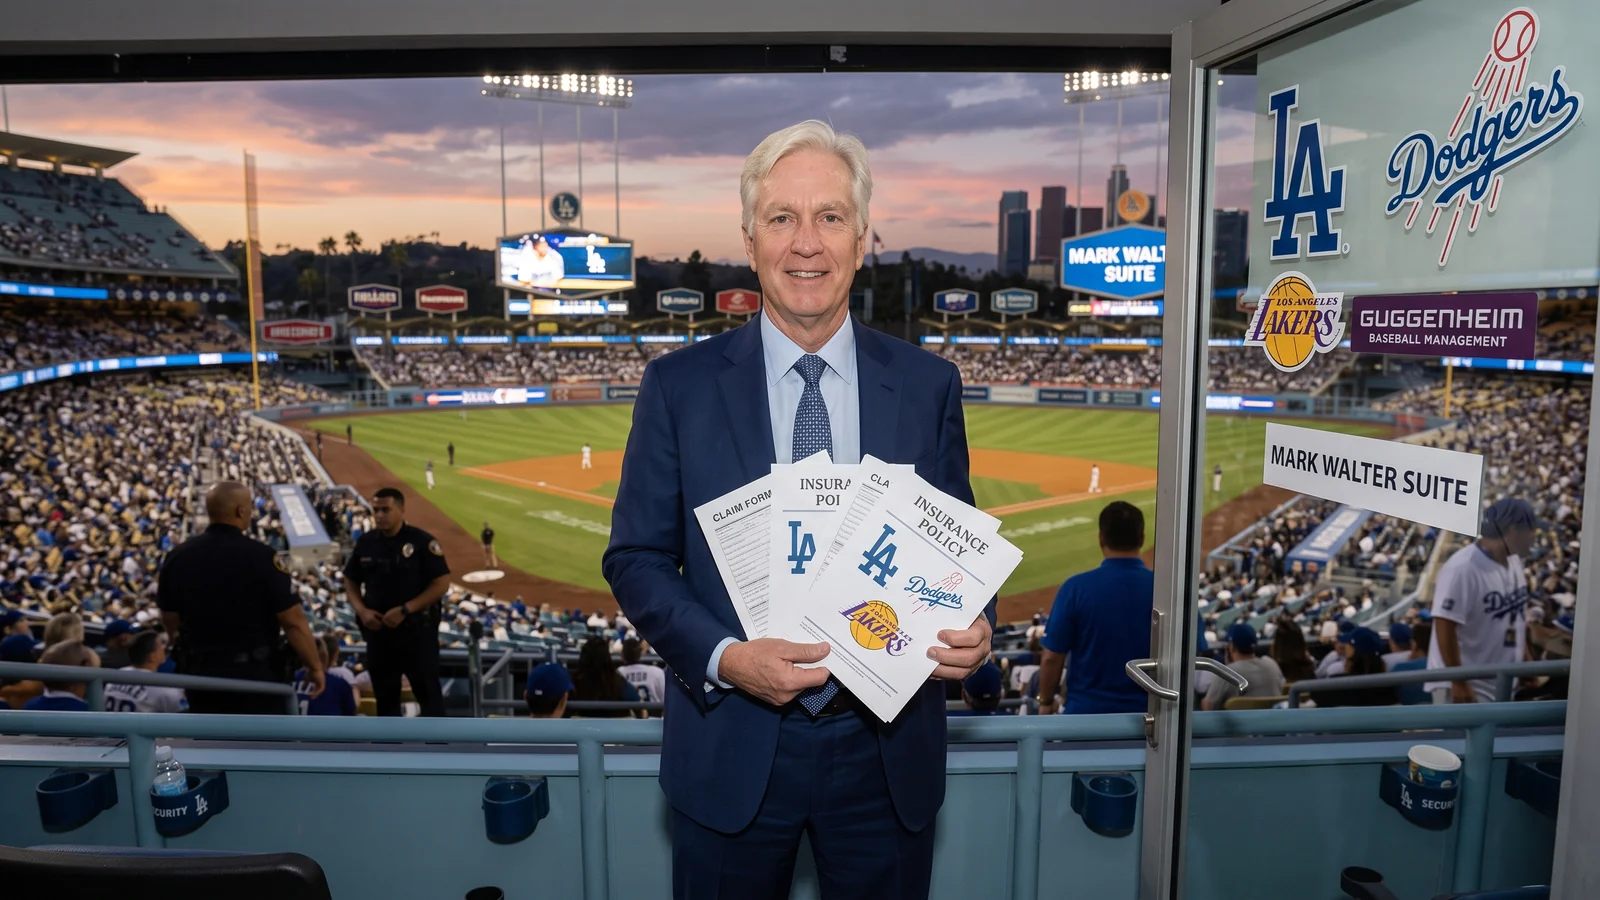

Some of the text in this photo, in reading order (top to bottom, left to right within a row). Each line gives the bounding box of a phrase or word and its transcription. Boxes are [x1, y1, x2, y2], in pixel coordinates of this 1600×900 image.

[1387, 69, 1578, 211] Dodgers
[1266, 89, 1344, 257] LA
[1069, 246, 1120, 264] MARK
[1104, 265, 1156, 283] SUITE
[1277, 297, 1338, 306] LOS ANGELES
[1248, 298, 1340, 347] LAKERS
[1360, 308, 1523, 329] GUGGENHEIM
[1369, 333, 1508, 347] BASEBALL MANAGEMENT
[1271, 444, 1468, 506] MARK WALTER SUITE
[712, 503, 744, 522] CLAIM
[914, 495, 989, 555] INSURANCE
[918, 518, 968, 557] POLICY
[857, 523, 899, 587] LA
[904, 576, 963, 609] Dodgers
[840, 601, 908, 656] LAKERS
[195, 794, 208, 816] LA
[1401, 783, 1413, 810] LA
